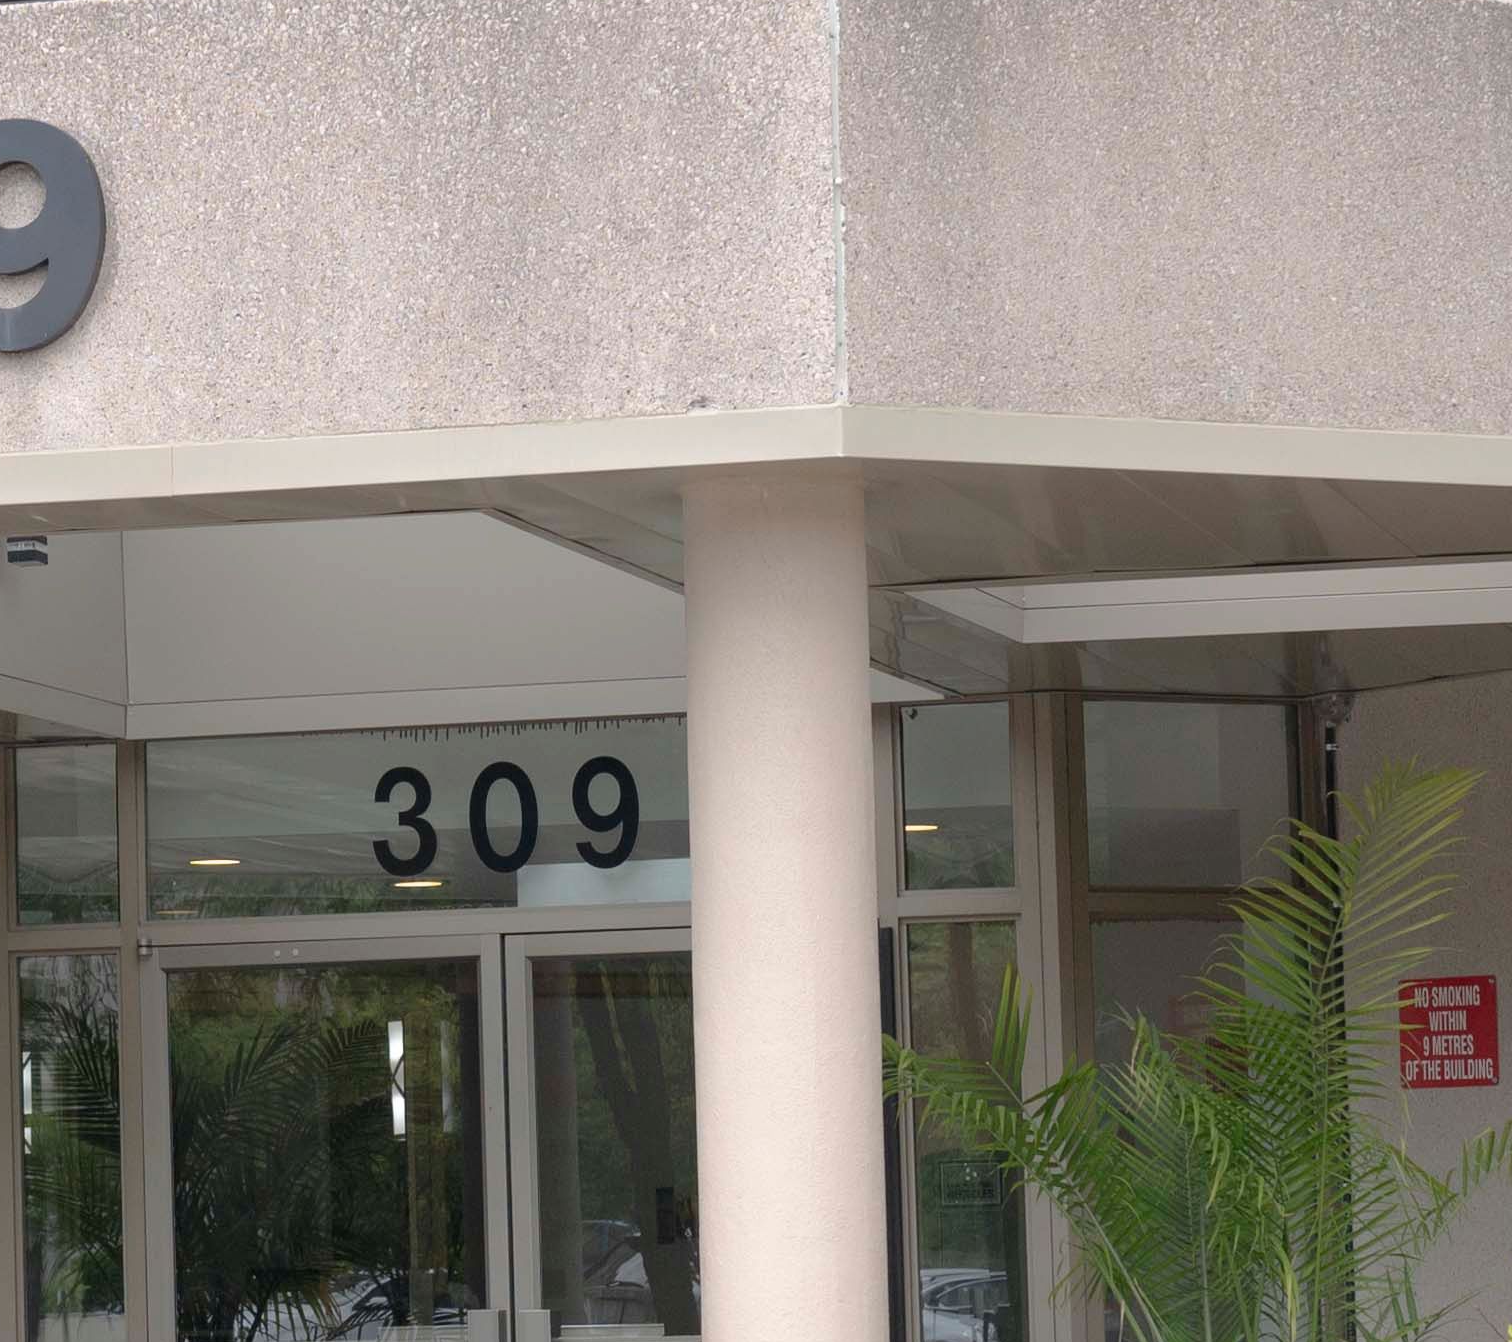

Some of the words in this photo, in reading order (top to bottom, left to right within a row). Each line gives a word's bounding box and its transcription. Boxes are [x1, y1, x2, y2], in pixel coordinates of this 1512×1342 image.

[372, 756, 641, 877] 309
[1414, 986, 1429, 1008] NO
[1431, 985, 1481, 1008] SMOKING
[1428, 1010, 1467, 1032] WITHIN
[1423, 1036, 1430, 1057] 9
[1432, 1034, 1474, 1056] METRES
[1406, 1060, 1419, 1082] OF
[1420, 1059, 1441, 1081] THE
[1444, 1058, 1494, 1080] BUILDING
